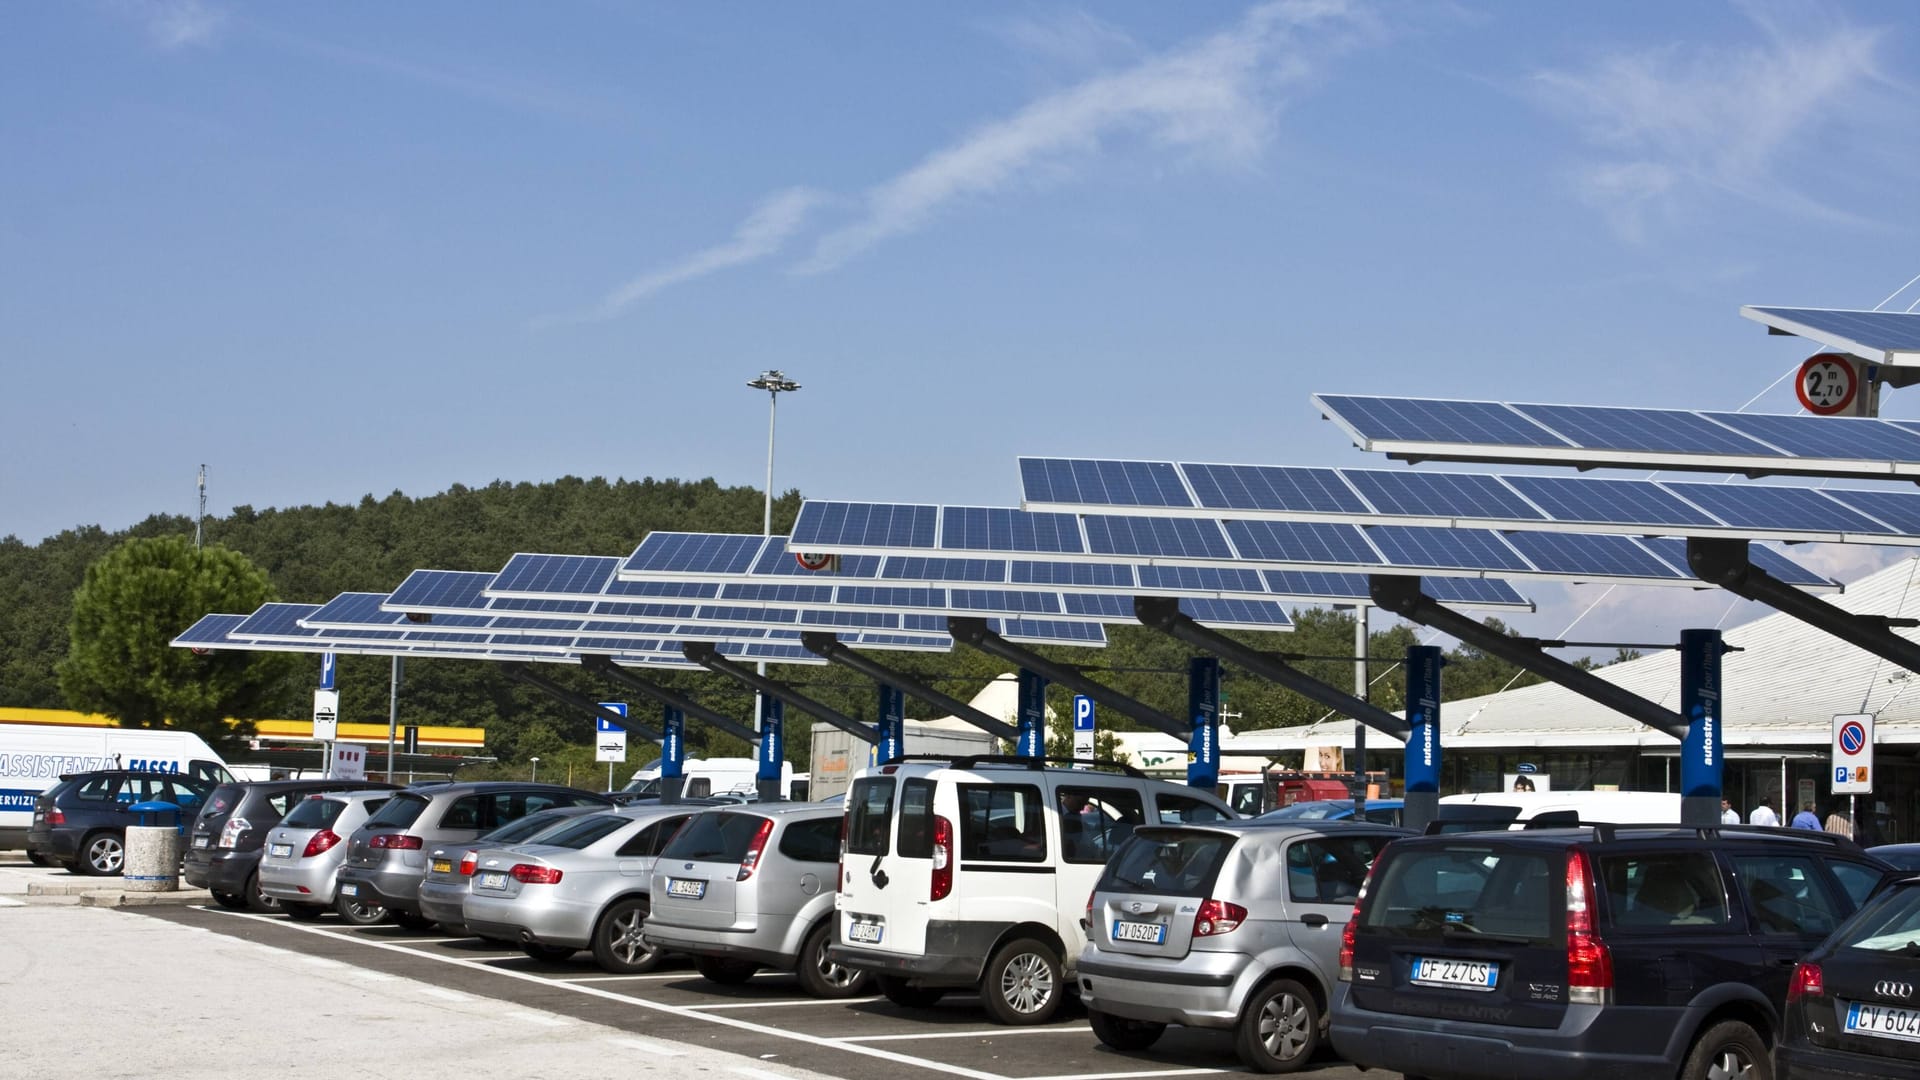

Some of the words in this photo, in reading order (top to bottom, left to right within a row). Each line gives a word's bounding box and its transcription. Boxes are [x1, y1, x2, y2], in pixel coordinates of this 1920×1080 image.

[1077, 699, 1091, 727] P
[887, 722, 895, 759] utostrade
[1028, 717, 1037, 757] utostrade
[1203, 711, 1211, 763] autostrade
[1423, 707, 1432, 766] autostrade
[1703, 700, 1713, 766] autostrade
[0, 754, 115, 778] ASSISTENZA
[129, 759, 179, 775] FASSA
[1837, 769, 1845, 781] P
[1119, 923, 1130, 938] CV
[1131, 925, 1159, 941] 052DF
[1357, 967, 1380, 976] VOLVO
[1421, 960, 1439, 979] CF
[1442, 962, 1487, 983] 247CS
[1859, 1006, 1880, 1029] CV
[1885, 1009, 1920, 1035] 604
